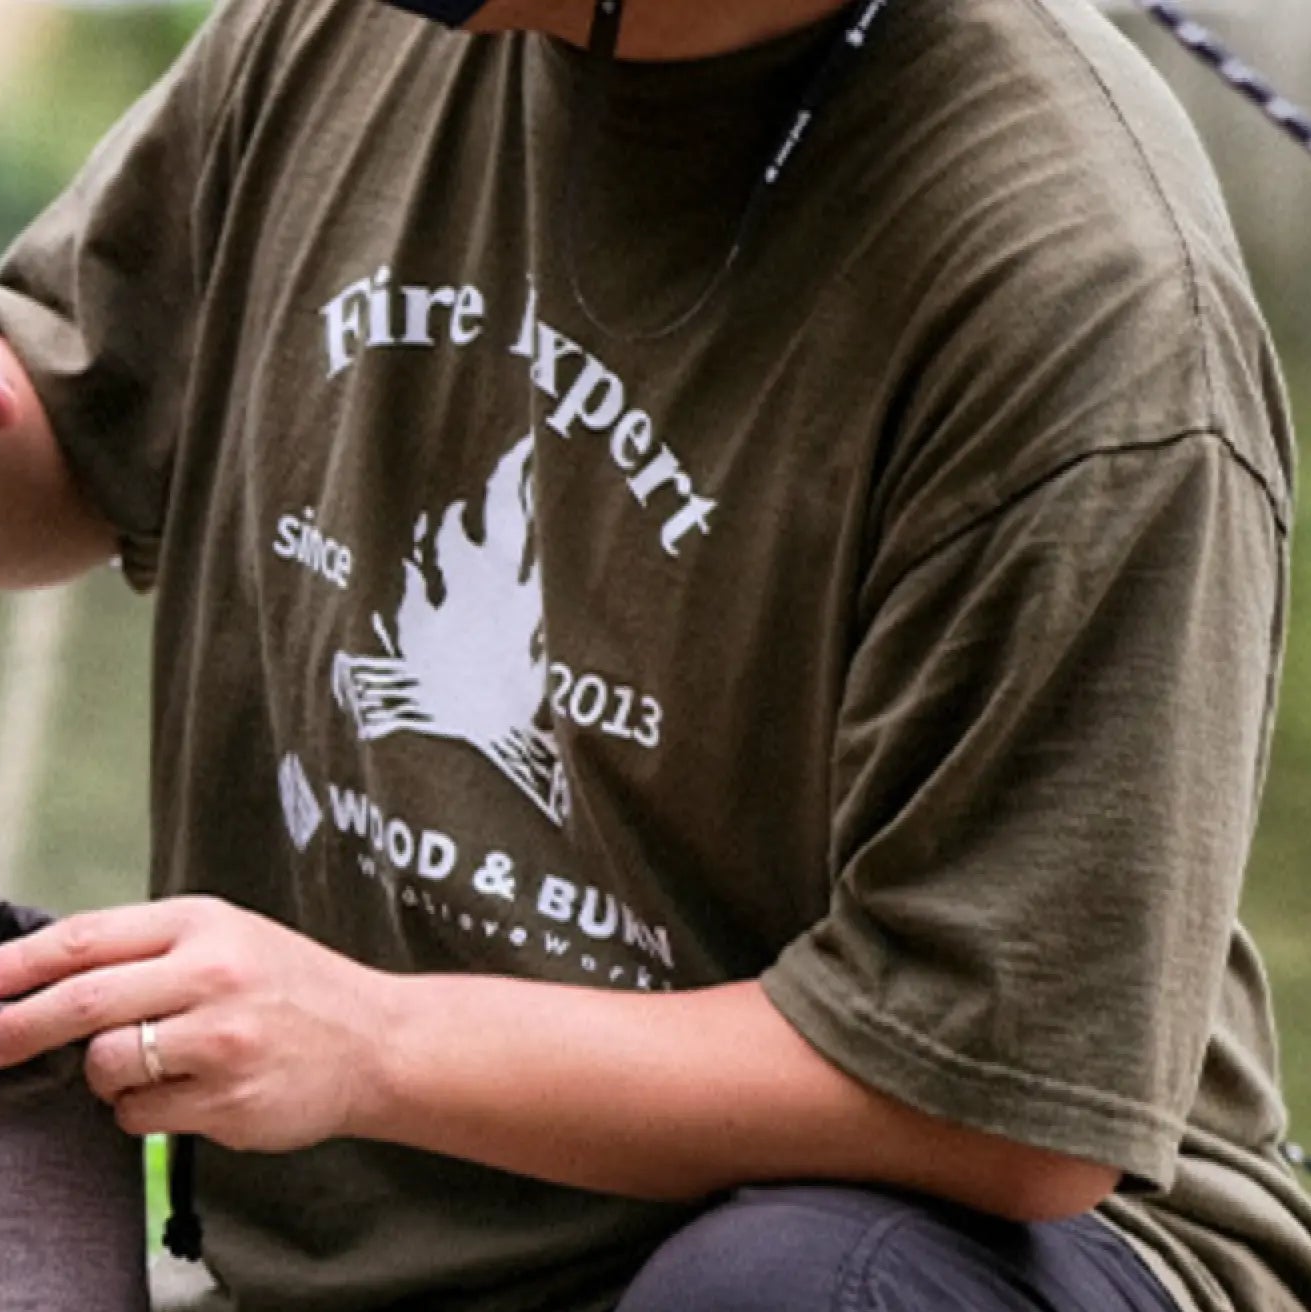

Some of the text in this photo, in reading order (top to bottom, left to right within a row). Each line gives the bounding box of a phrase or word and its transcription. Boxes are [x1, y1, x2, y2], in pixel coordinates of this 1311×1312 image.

[319, 264, 485, 371] Fire
[272, 505, 352, 590] since
[549, 661, 663, 749] 2013
[328, 783, 458, 880] WOOD
[473, 848, 516, 901] &
